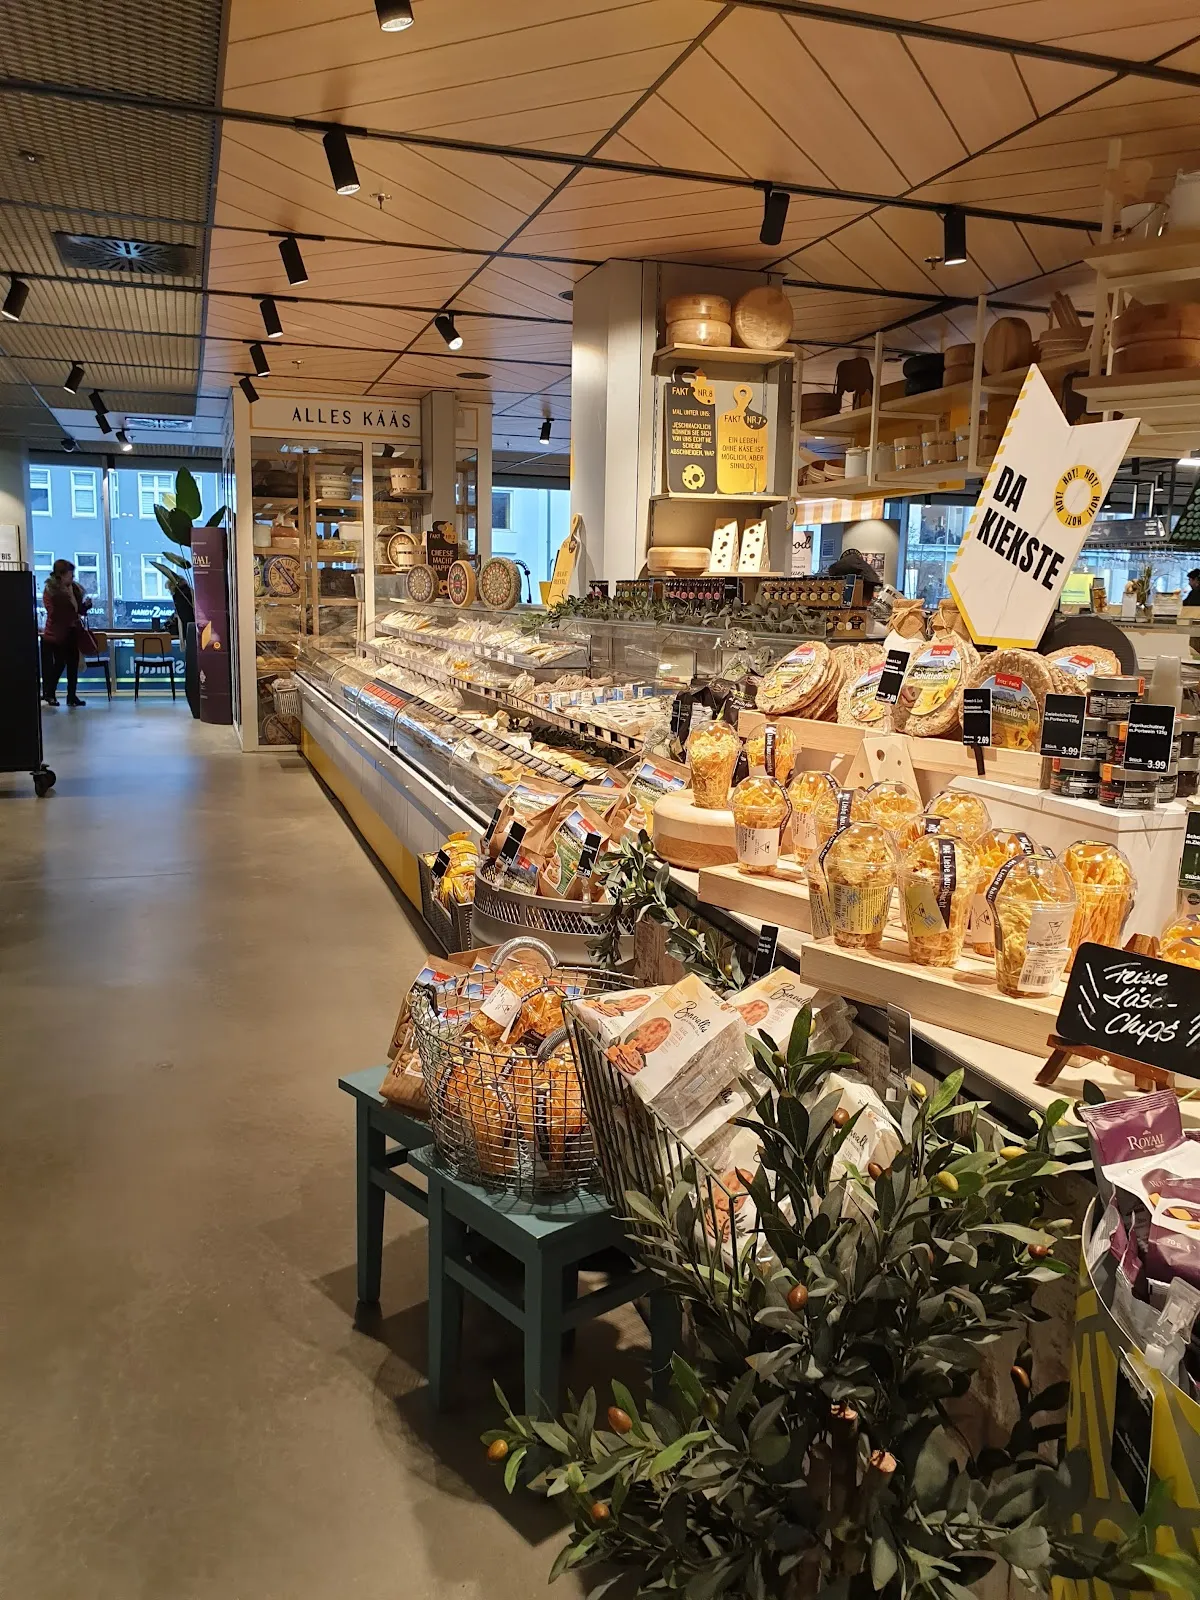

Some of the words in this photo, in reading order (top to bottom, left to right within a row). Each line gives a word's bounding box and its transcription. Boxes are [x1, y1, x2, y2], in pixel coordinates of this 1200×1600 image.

[672, 387, 689, 396] FAKT
[697, 389, 713, 397] NR.8
[292, 406, 352, 425] ALLES
[363, 409, 411, 428] KÄÄS
[672, 408, 683, 416] MAL
[746, 416, 762, 425] NR.7
[1062, 468, 1079, 486] HOT!
[1084, 468, 1100, 488] HOT!
[992, 465, 1028, 513] DA
[1056, 492, 1064, 513] HOT!
[1086, 496, 1101, 518] HOT!
[1064, 514, 1082, 526] HOT!
[430, 550, 454, 558] CHEESE
[976, 506, 1066, 591] KIEKSTE
[432, 556, 454, 564] MACHT
[978, 736, 989, 744] 2.69
[1061, 746, 1078, 756] 3.99
[1147, 760, 1166, 770] 3.99
[942, 856, 952, 874] Liebe
[995, 868, 1009, 886] Liebe
[1104, 1012, 1180, 1046] Chips
